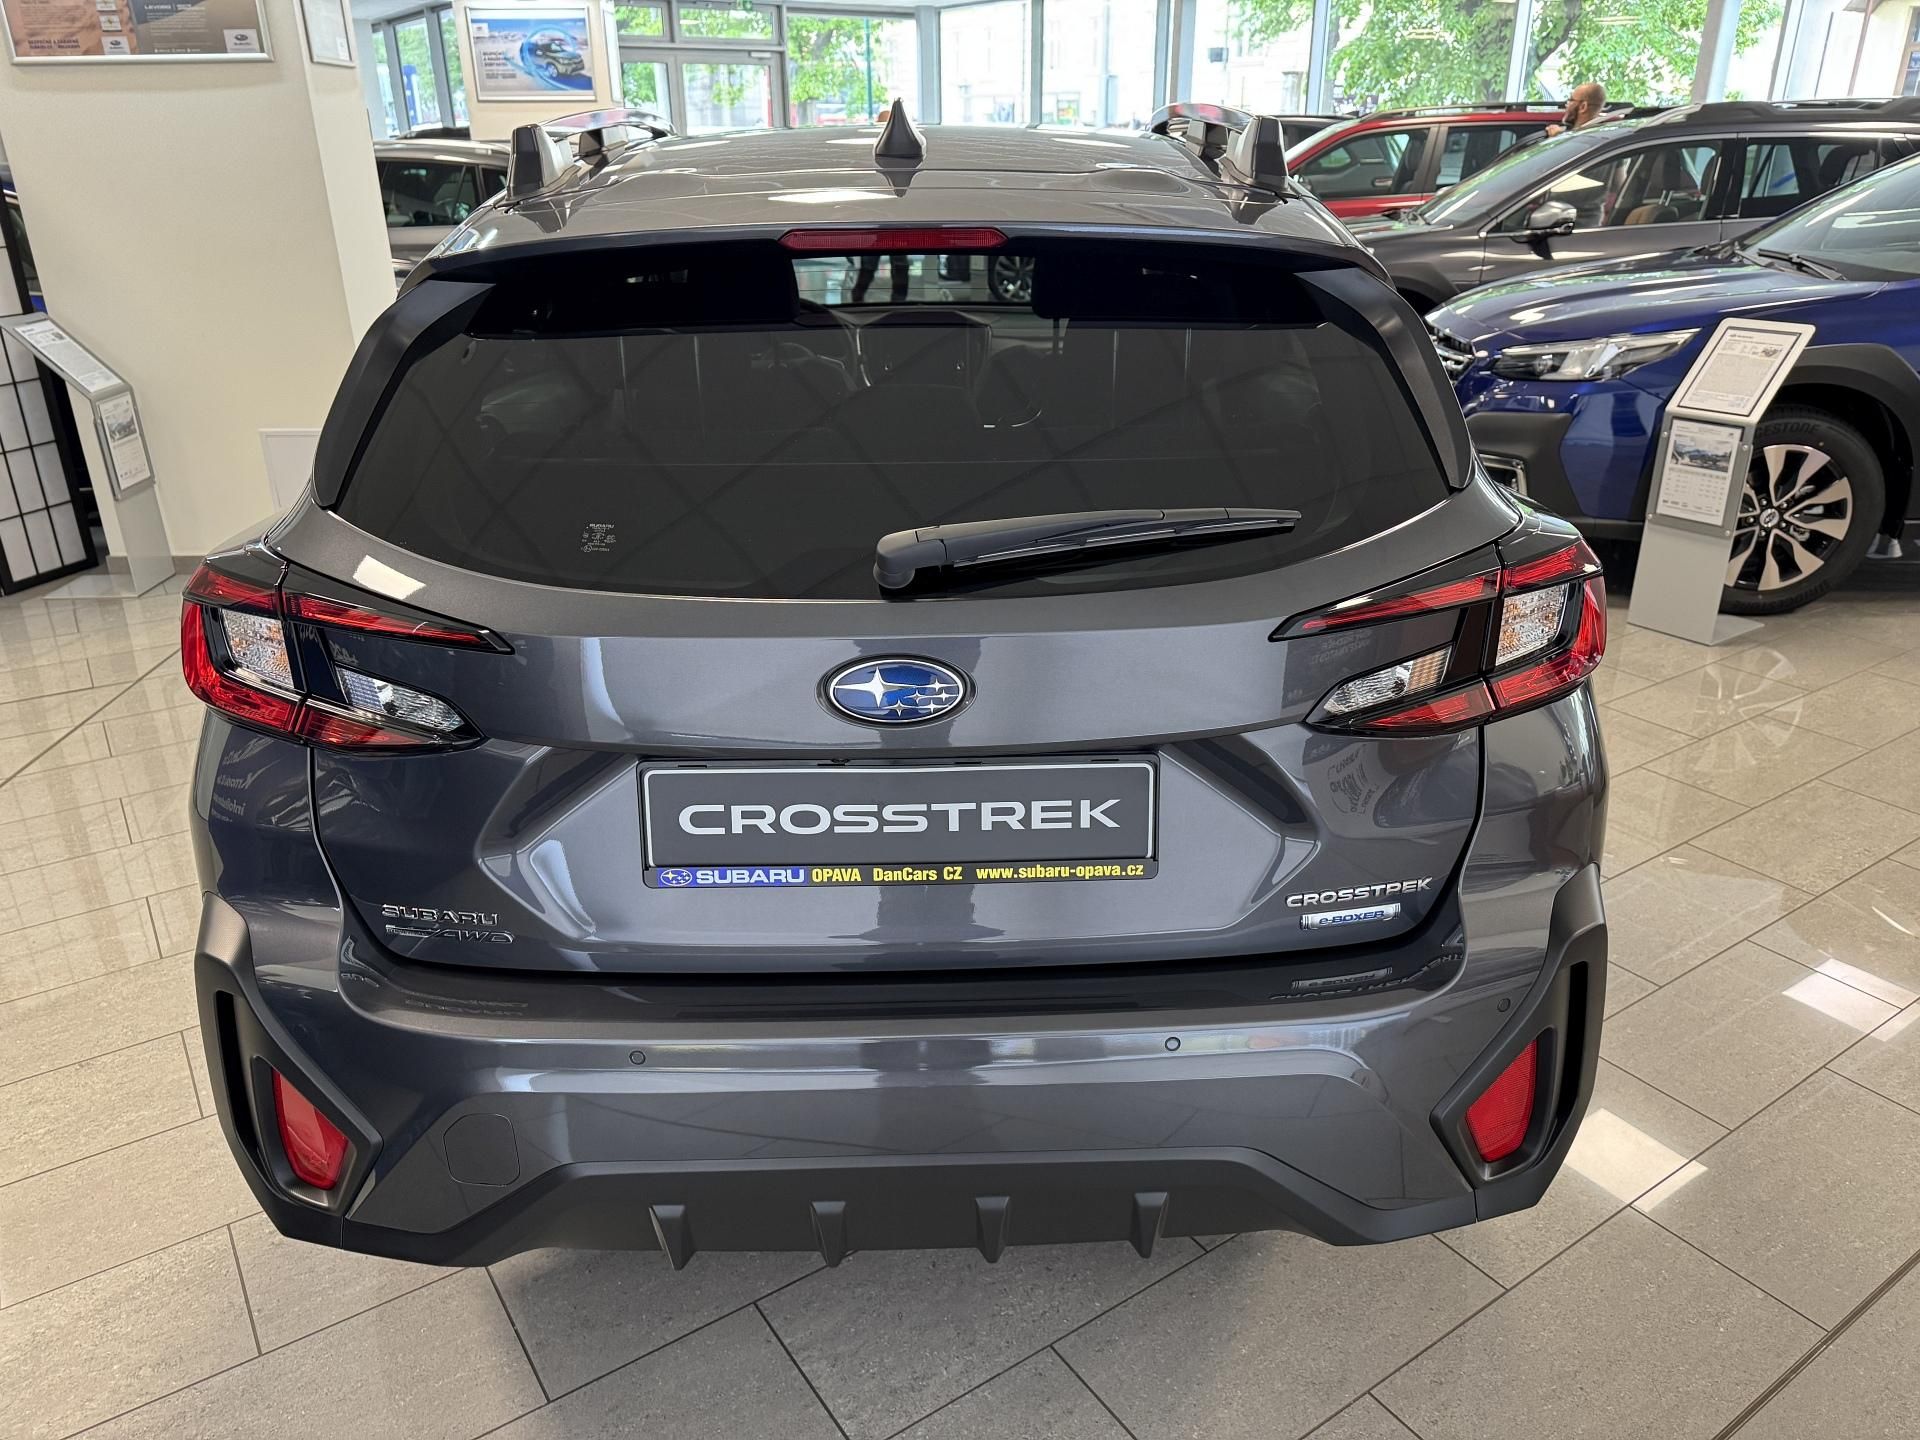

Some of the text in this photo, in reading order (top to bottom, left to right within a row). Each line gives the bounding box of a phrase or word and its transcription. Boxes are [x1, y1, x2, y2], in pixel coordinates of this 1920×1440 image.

[678, 799, 1121, 835] CROSSTREK
[696, 863, 1144, 884] SUBARU OPAVA DanCars CZ www.subaru-opava.cz
[1286, 877, 1433, 908] CROSSTREK
[381, 903, 499, 926] SUBARU
[1318, 909, 1385, 926] e-BOXER
[434, 928, 514, 943] AWD
